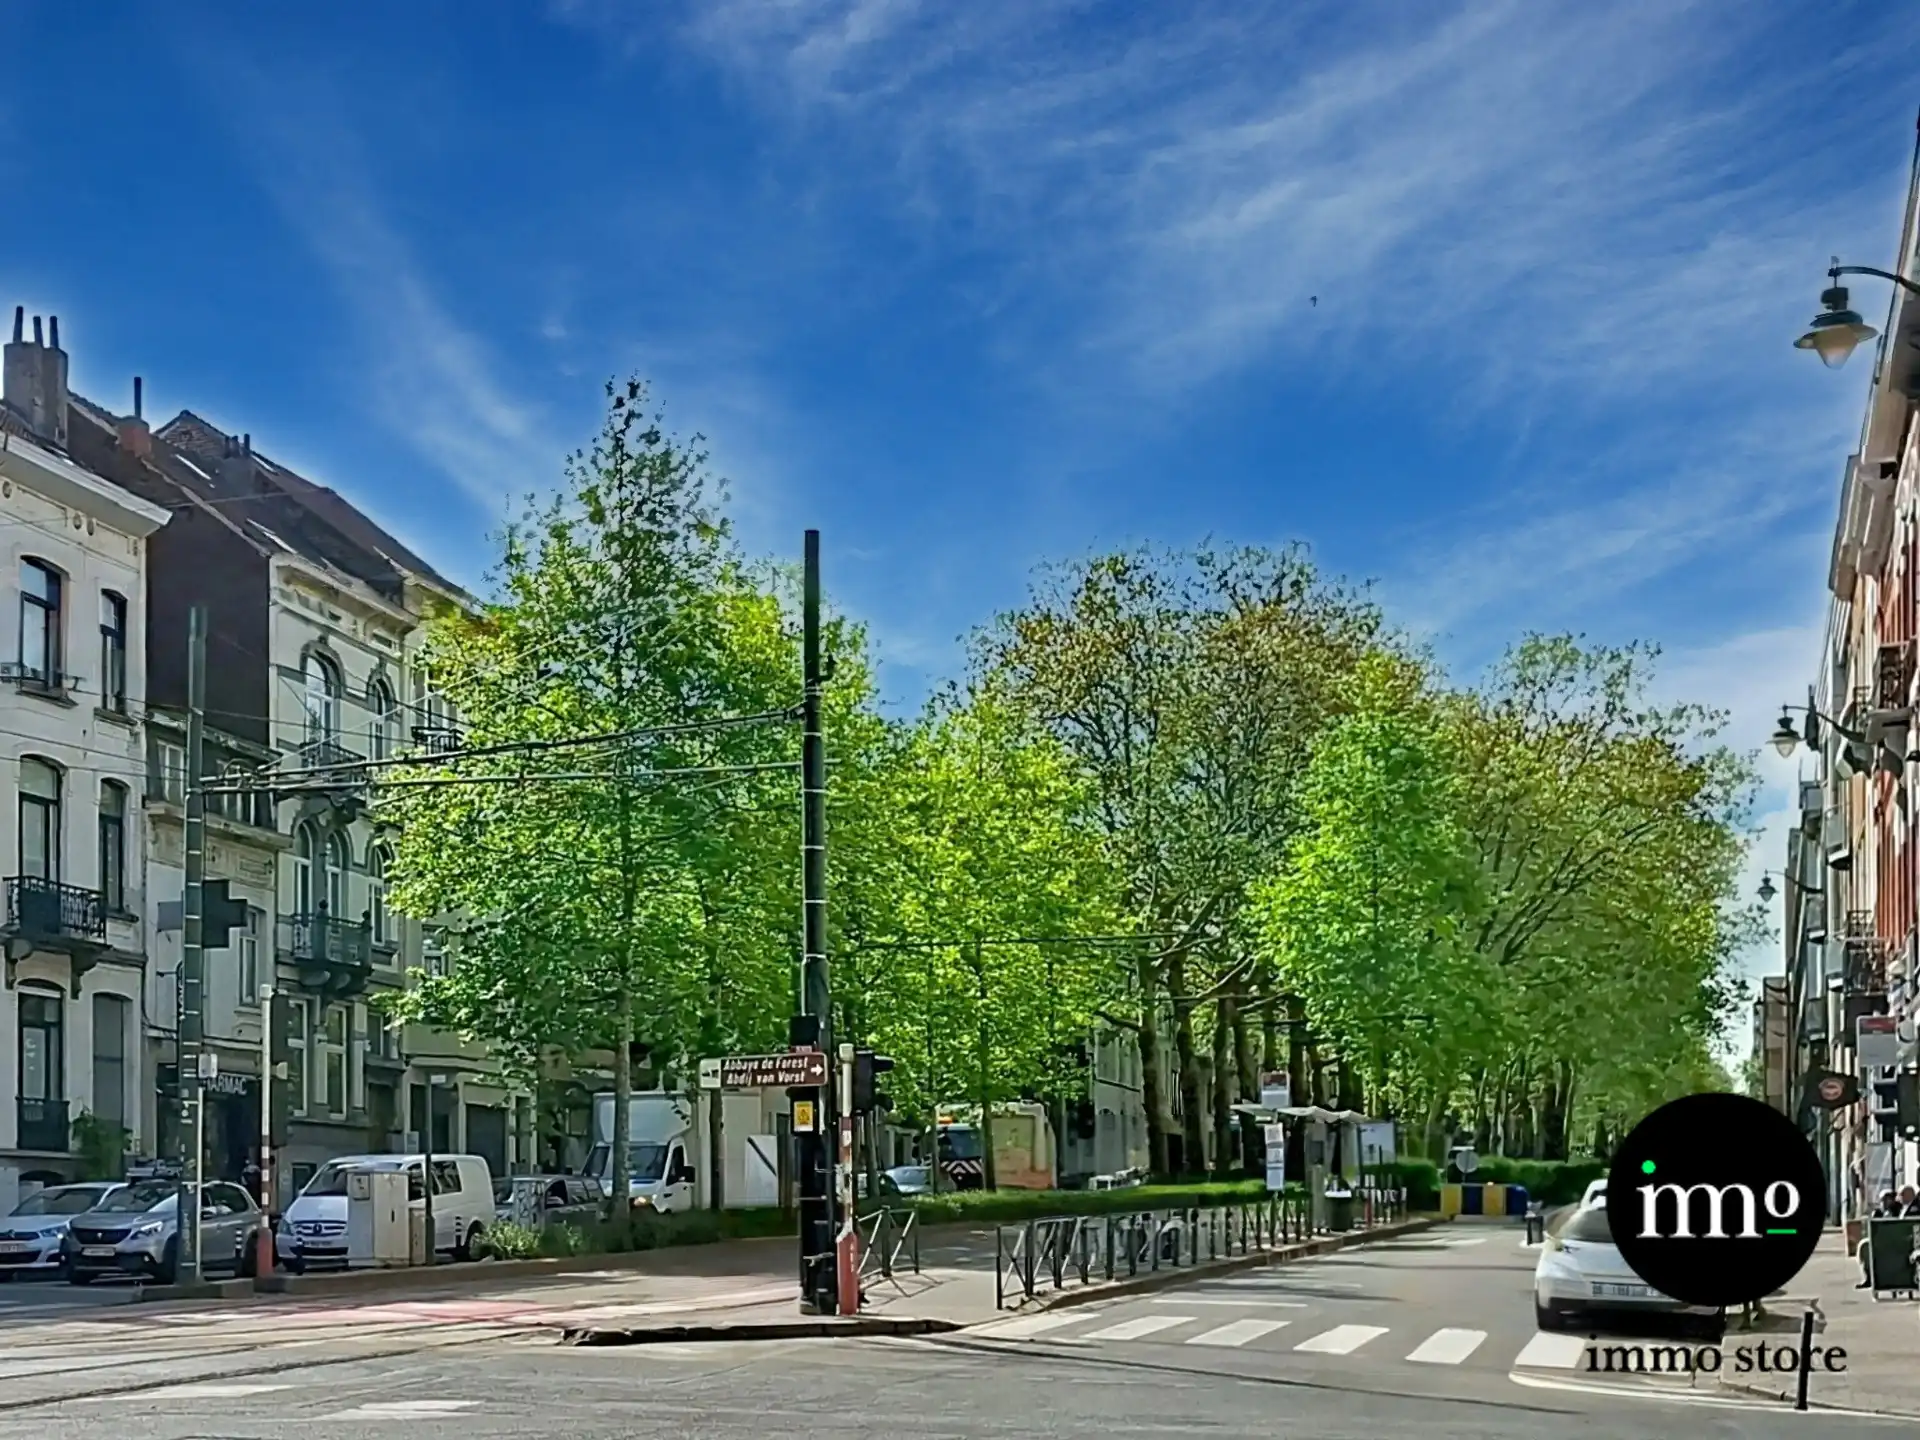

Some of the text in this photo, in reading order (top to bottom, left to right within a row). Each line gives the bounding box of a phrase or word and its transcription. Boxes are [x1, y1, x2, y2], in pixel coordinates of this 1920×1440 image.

[723, 1058, 759, 1073] Abbaye
[761, 1057, 774, 1070] de
[756, 1074, 775, 1084] van
[778, 1070, 805, 1083] Vorst
